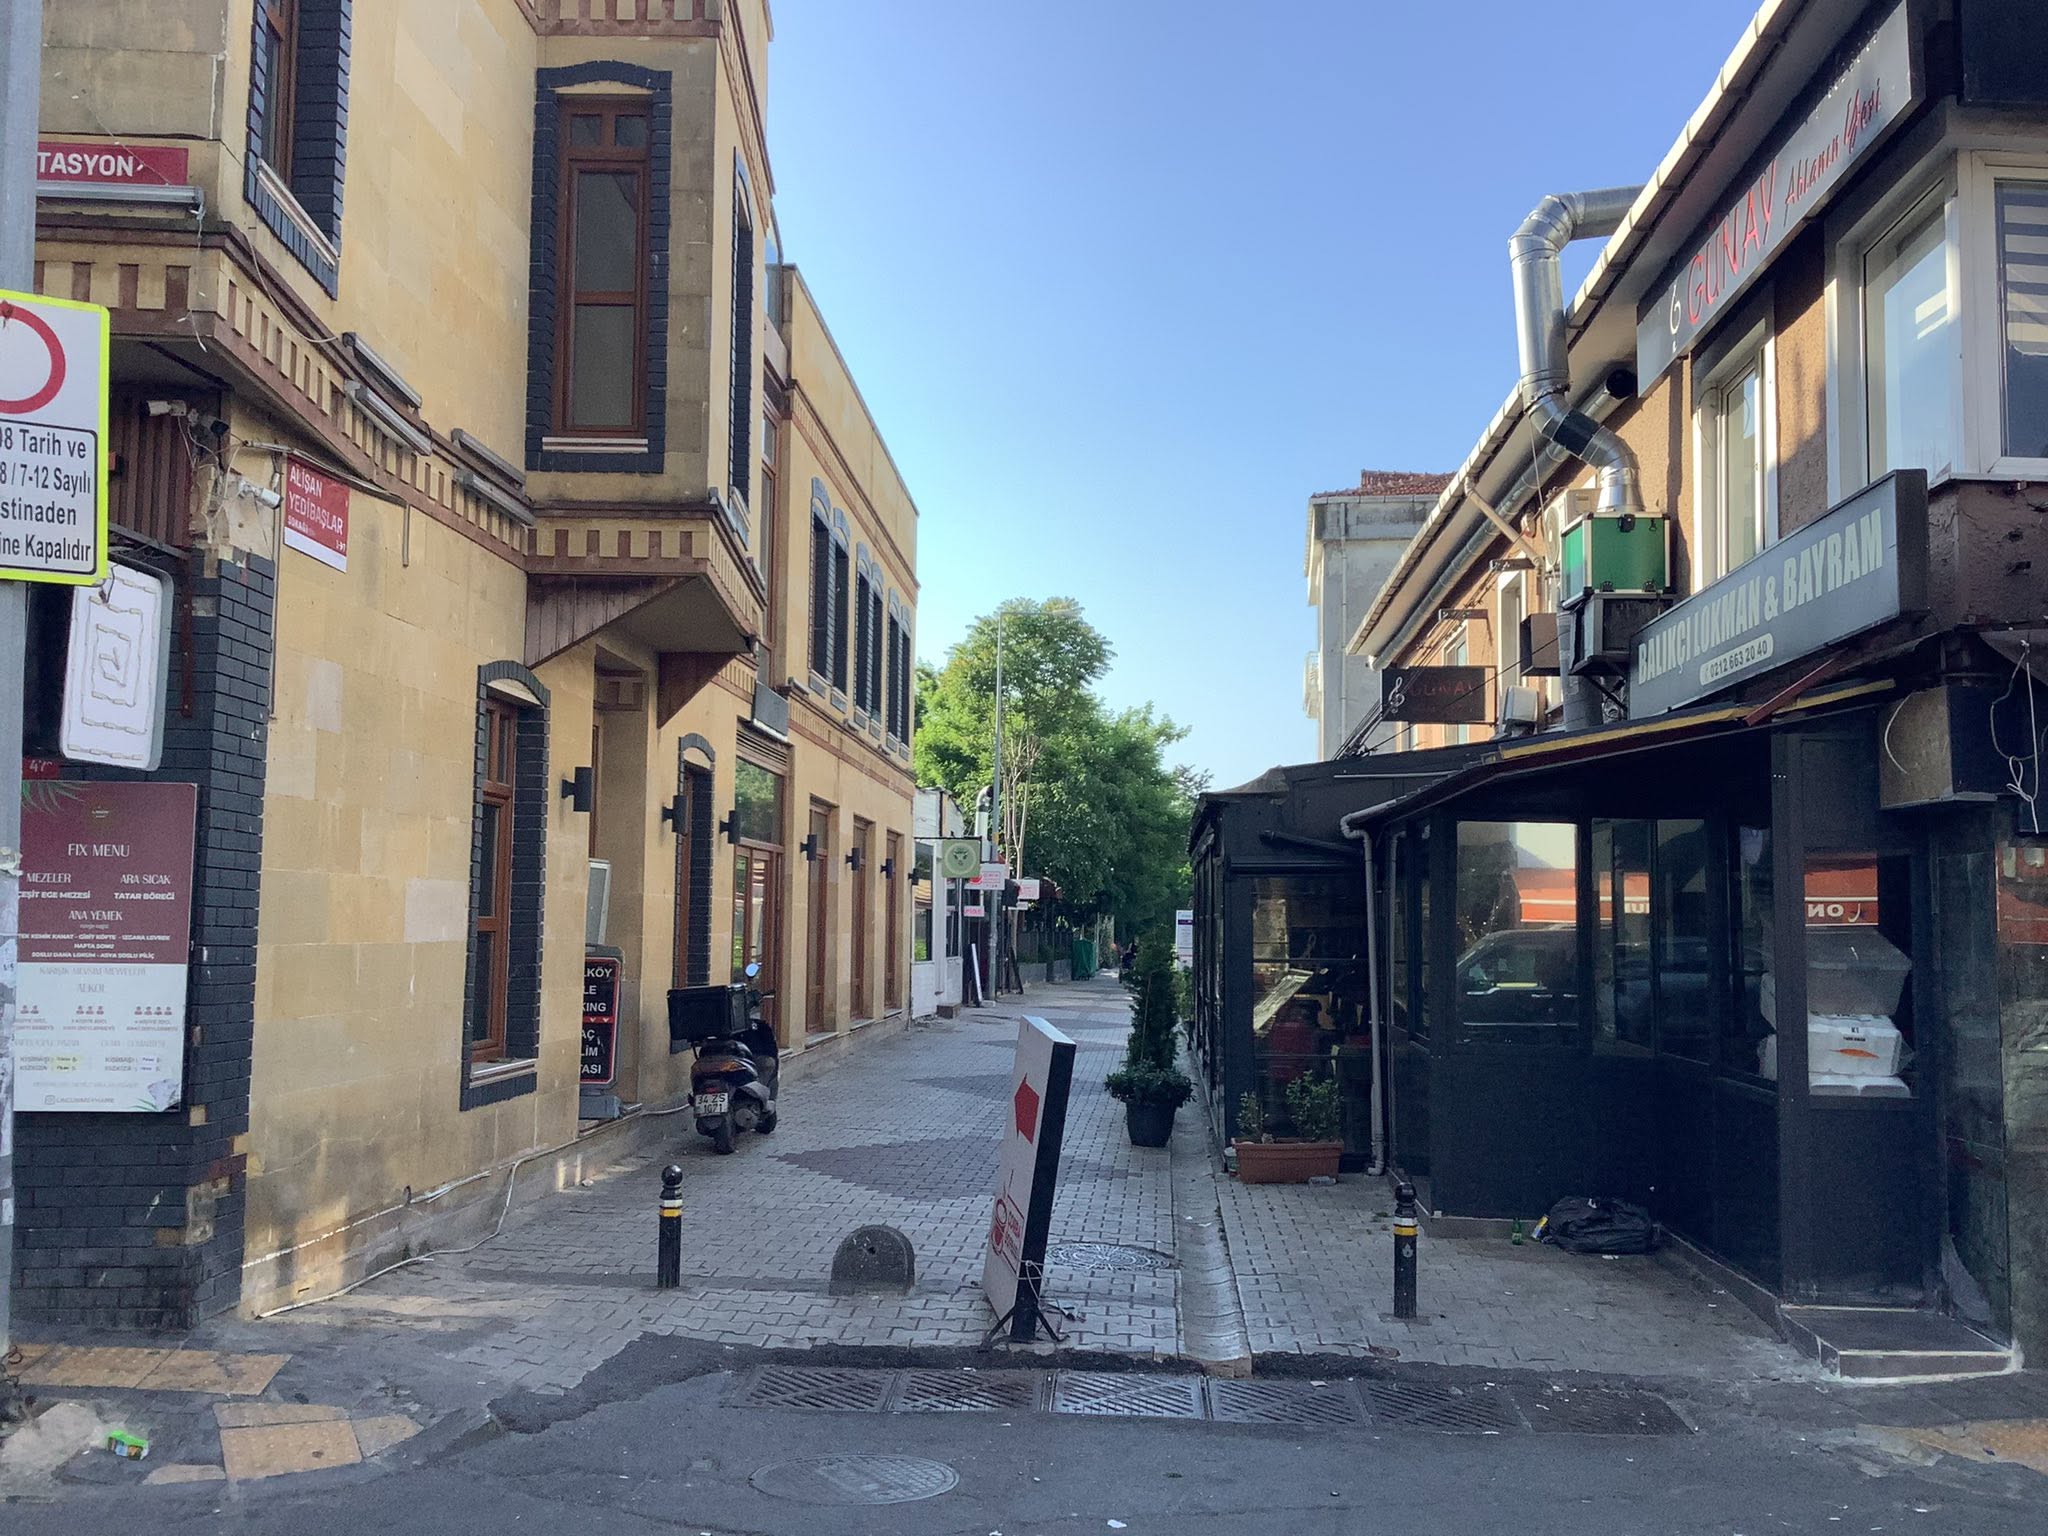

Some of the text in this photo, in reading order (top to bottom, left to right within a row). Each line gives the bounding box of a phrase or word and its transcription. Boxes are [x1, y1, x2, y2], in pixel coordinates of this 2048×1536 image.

[0, 426, 87, 459] 8 Tarih ve
[20, 463, 49, 489] 7-12
[53, 467, 91, 498] Sayılı
[290, 465, 323, 499] ALİŞAN
[288, 490, 343, 536] YEDİBAŞLAR
[25, 533, 91, 564] Kapalıdır
[1638, 507, 1882, 685] BALIKÇI LOKMAN & BAYRAM
[1709, 639, 1768, 678] 0212 663 20 40
[68, 843, 131, 858] FIX MENU
[26, 872, 71, 884] MEZELER
[120, 873, 172, 886] ARA SICAK
[59, 890, 91, 899] MEZESİ
[114, 890, 175, 901] TATAR BÖREĞİ
[68, 910, 123, 921] ANA YEMEK
